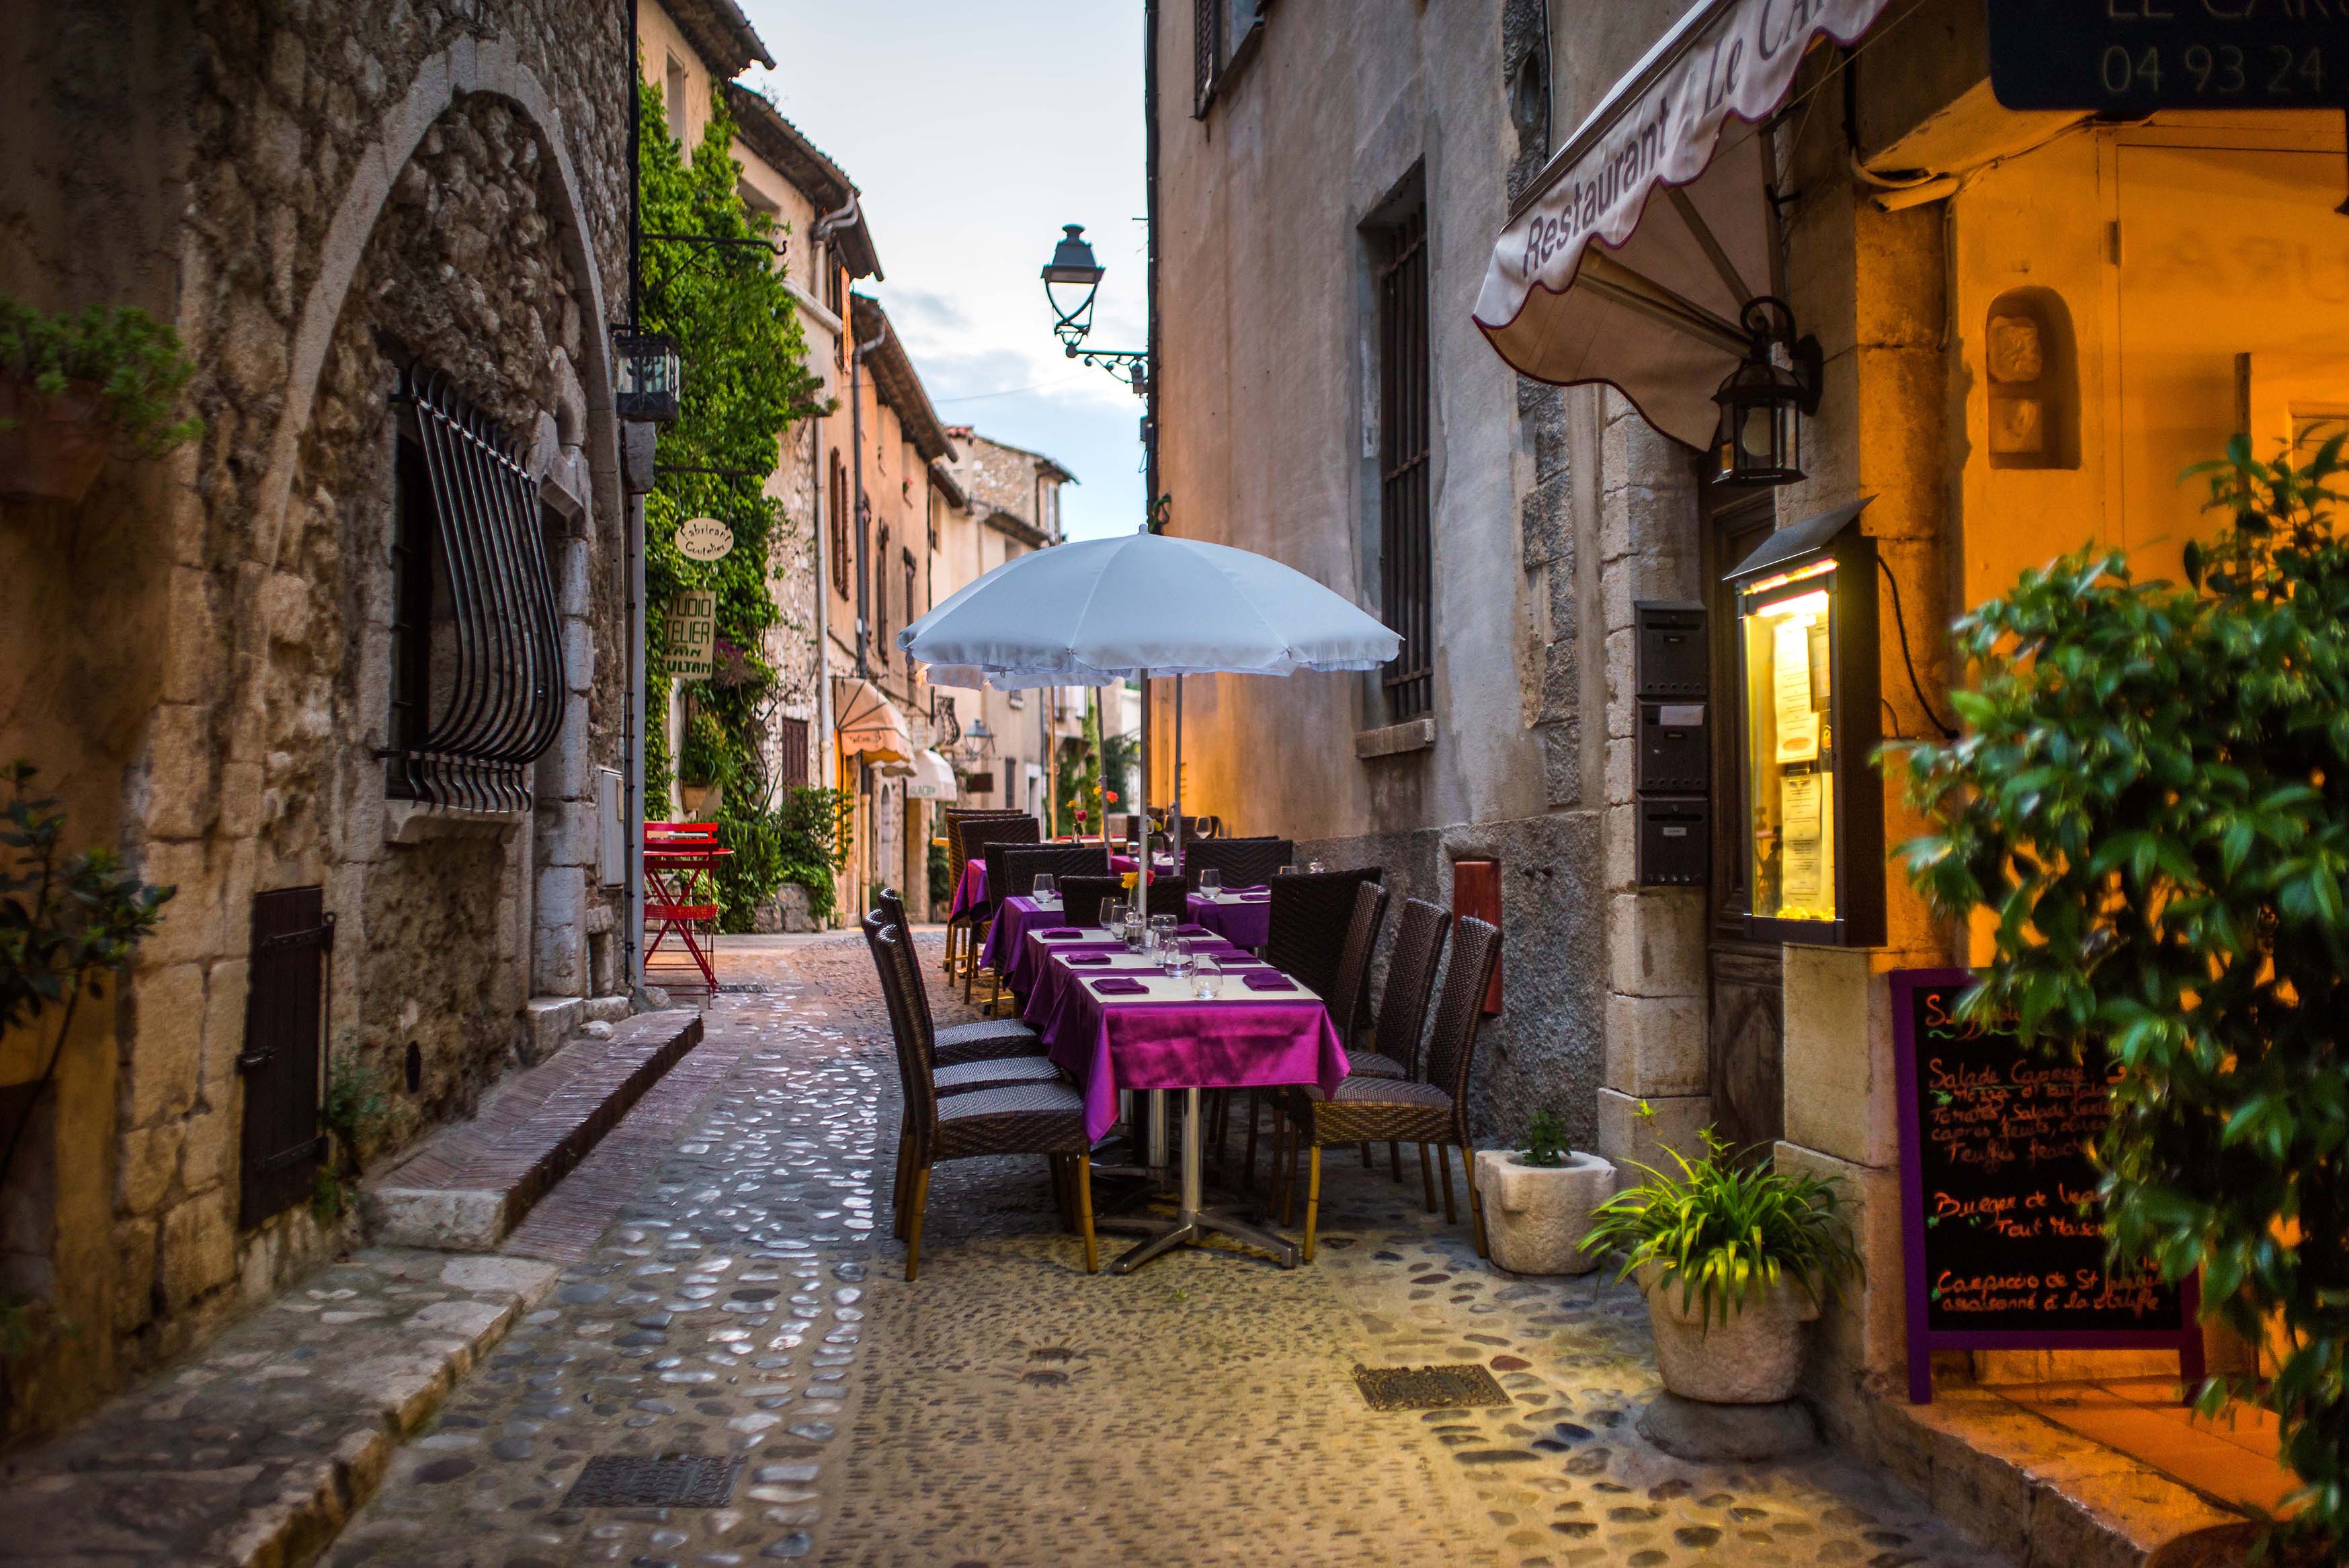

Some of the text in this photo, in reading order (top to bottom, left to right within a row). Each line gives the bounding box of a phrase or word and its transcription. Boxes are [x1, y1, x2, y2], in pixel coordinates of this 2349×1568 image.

[2103, 45, 2320, 93] 04 93 24
[1524, 97, 1671, 278] Restaurant
[1700, 38, 1743, 120] Le
[666, 620, 710, 645] TELIER
[666, 659, 711, 674] ULTAN
